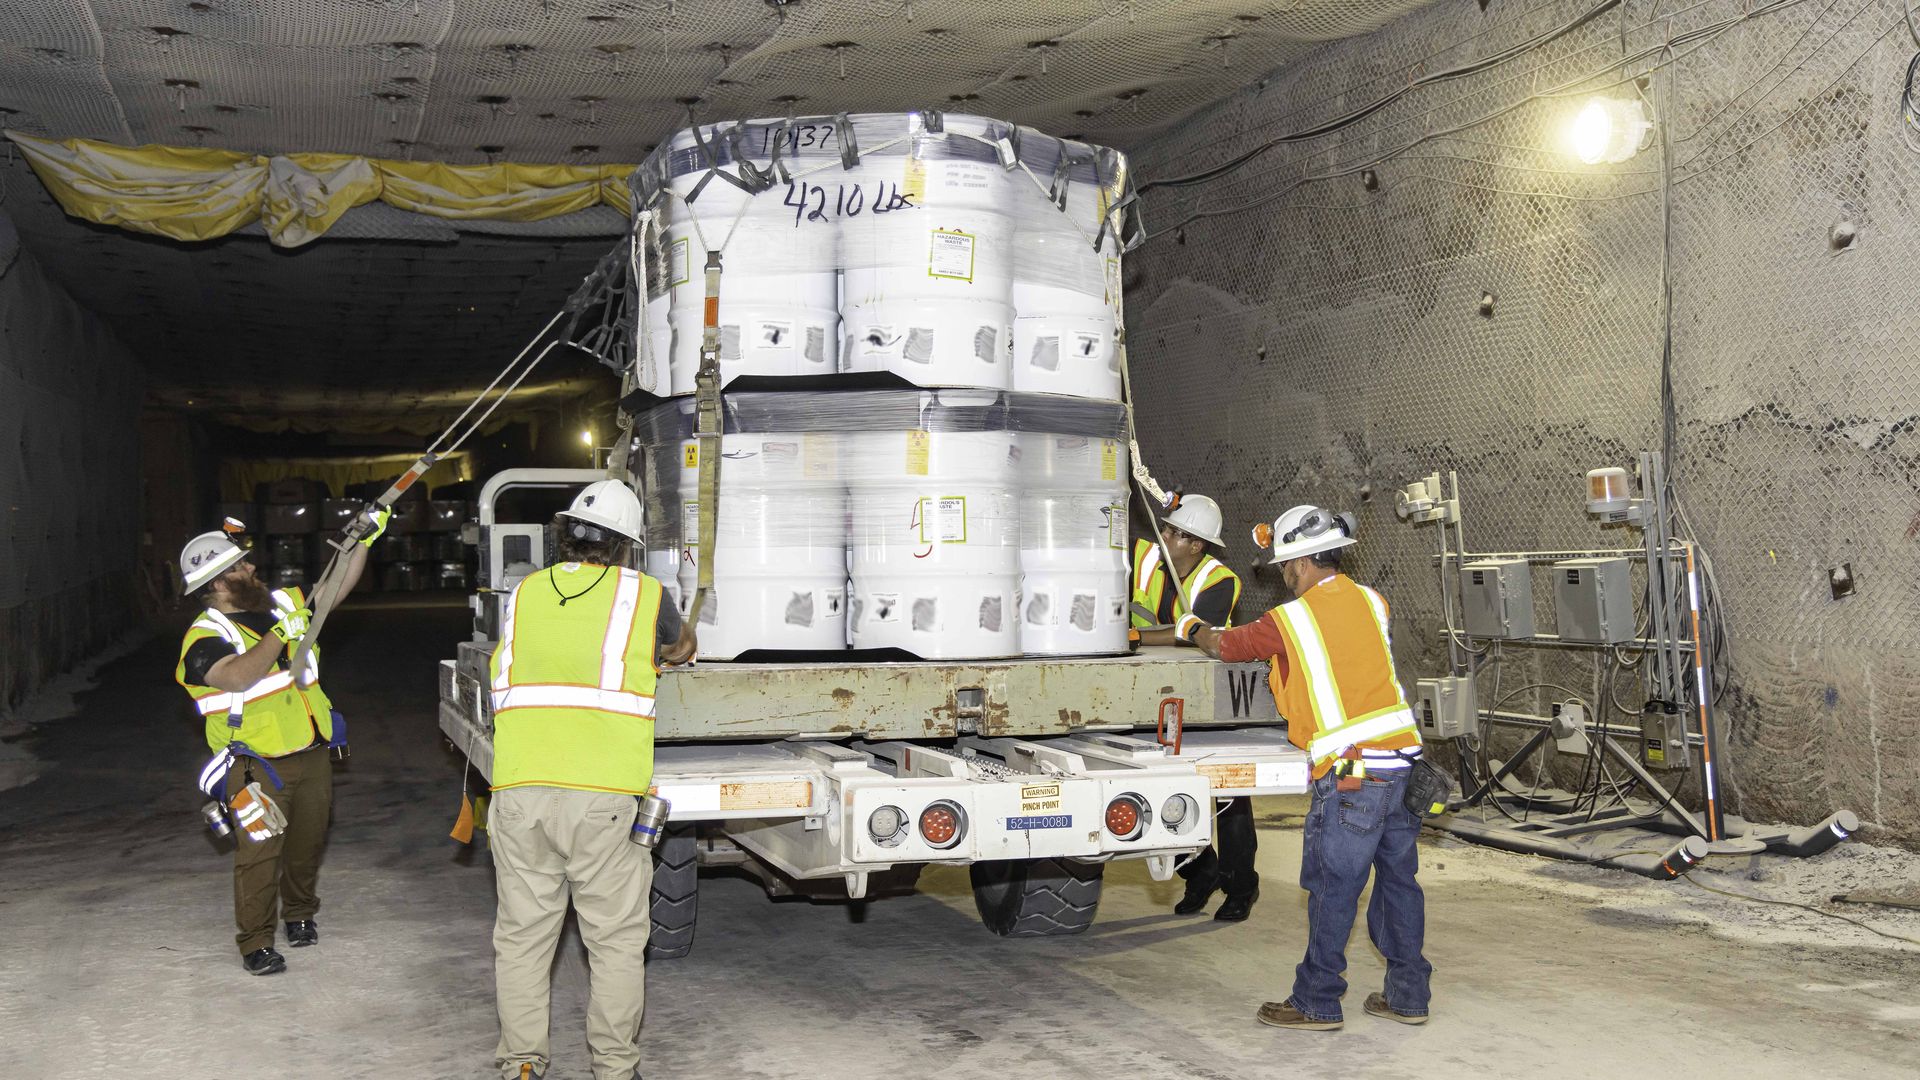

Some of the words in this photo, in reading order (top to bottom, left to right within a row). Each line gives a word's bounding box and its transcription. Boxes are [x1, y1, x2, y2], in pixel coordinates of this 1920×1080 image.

[784, 181, 864, 228] 4210
[937, 235, 970, 243] HAZARDOUS
[1228, 670, 1257, 718] W
[1025, 787, 1055, 797] WARNING
[1022, 802, 1040, 811] PINCH
[1042, 800, 1059, 809] POINT
[1010, 816, 1068, 829] 52-H-008D
